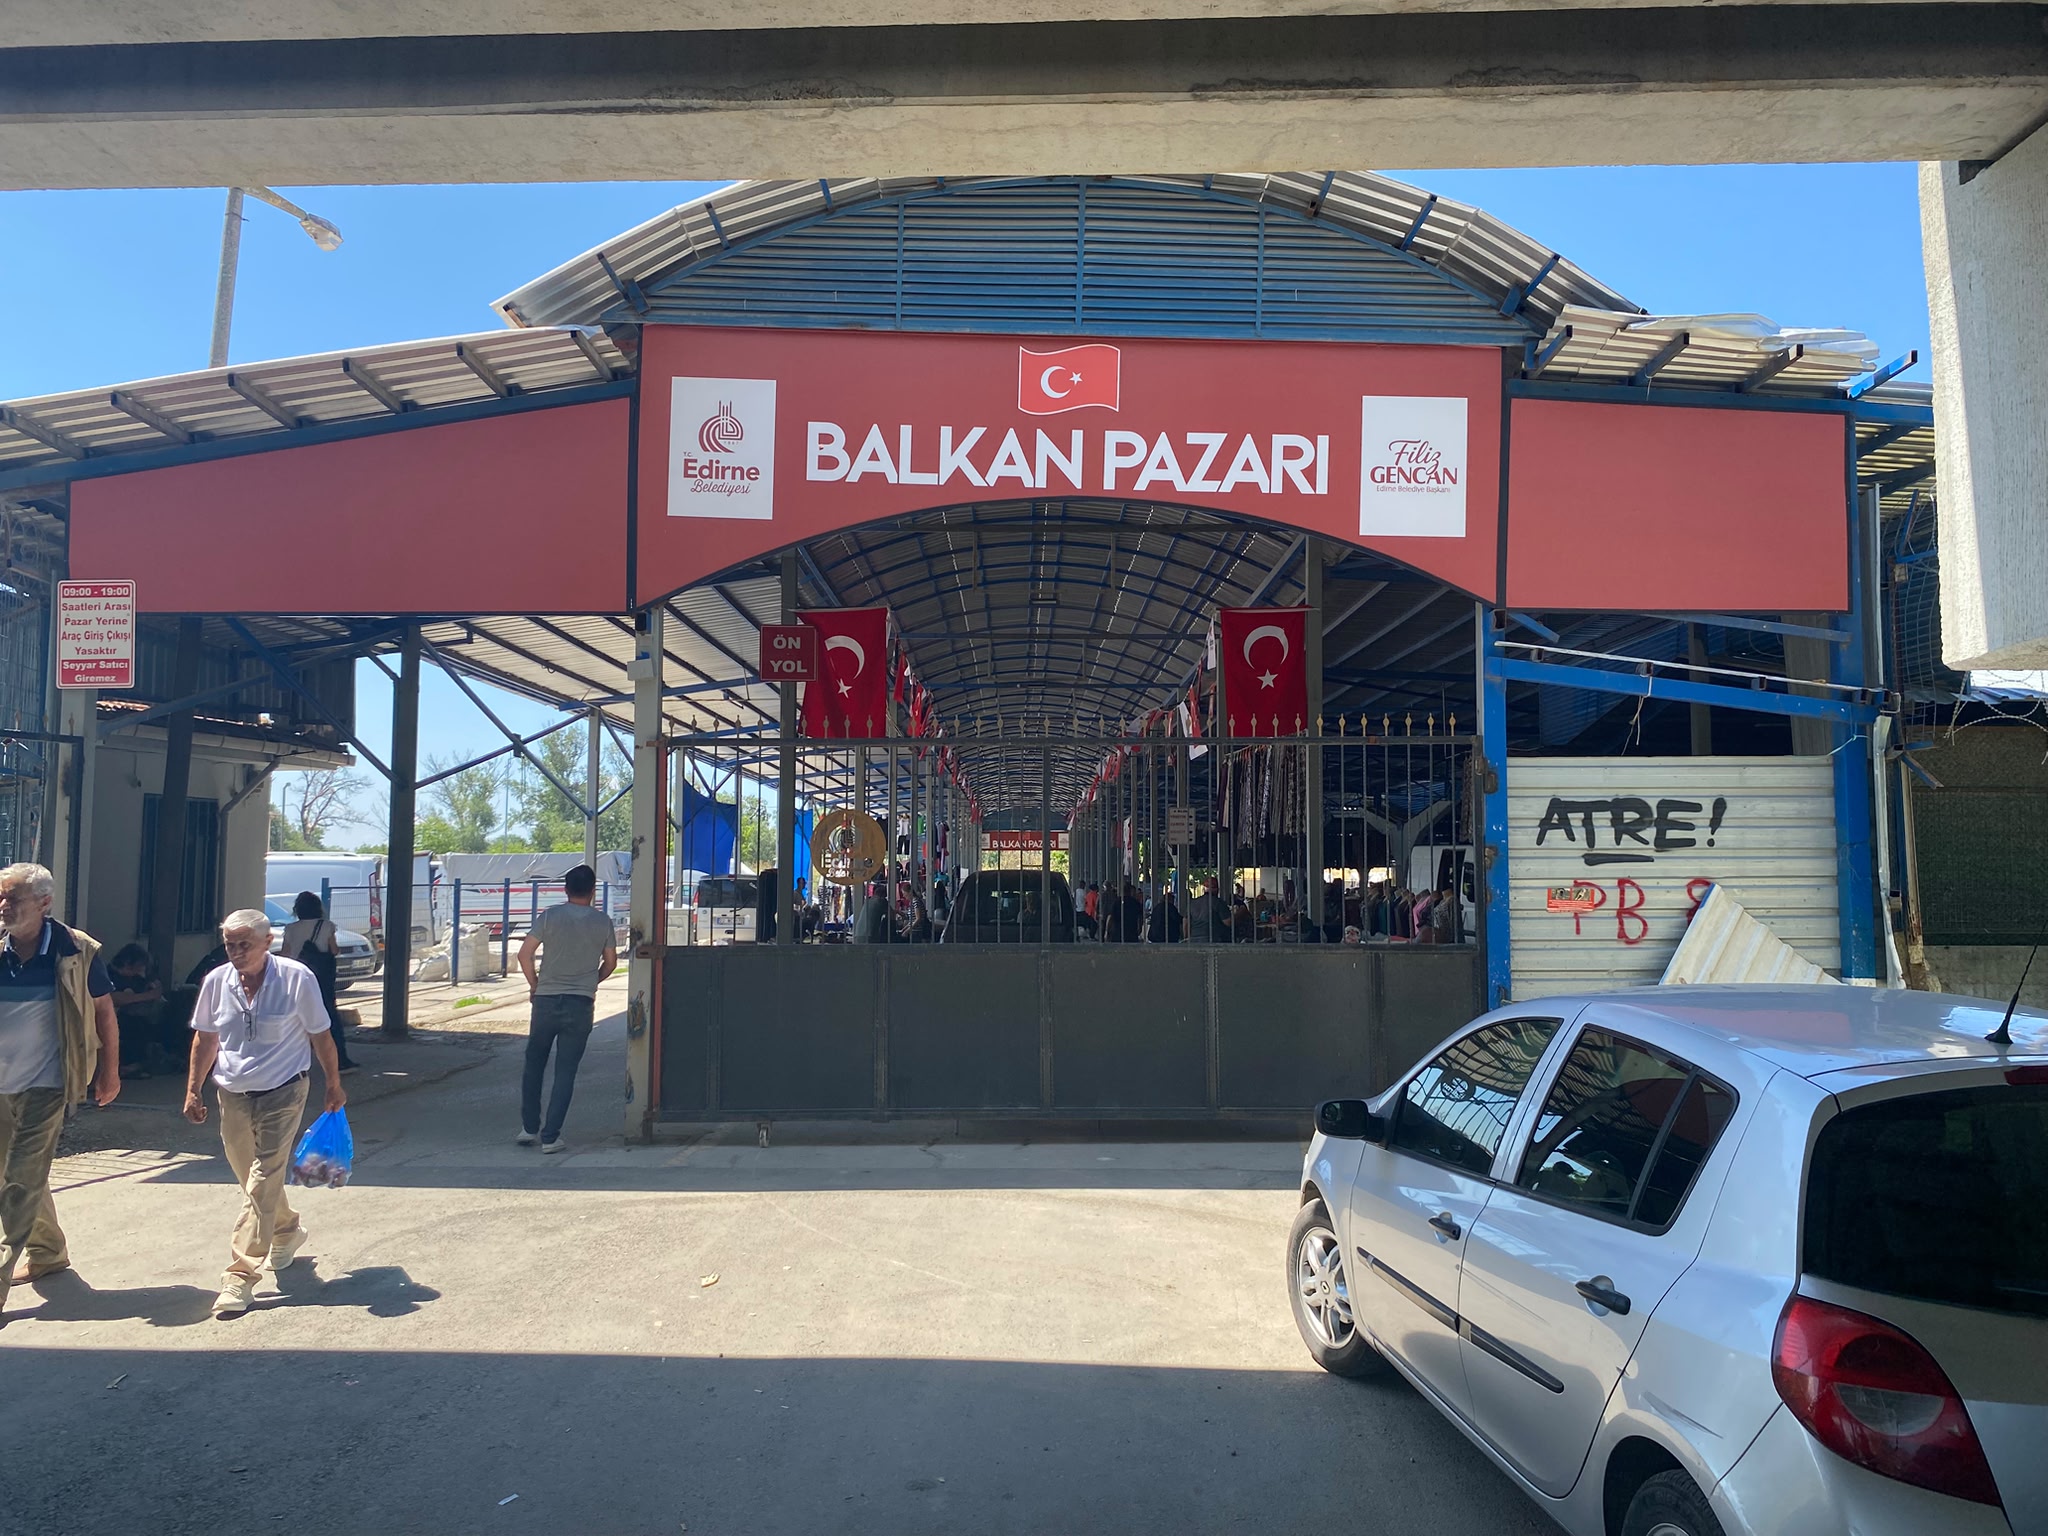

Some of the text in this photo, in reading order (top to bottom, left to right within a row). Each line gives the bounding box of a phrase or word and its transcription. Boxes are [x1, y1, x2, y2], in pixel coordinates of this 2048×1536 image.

[806, 421, 1329, 495] BALKAN PAZARI
[1388, 439, 1441, 476] Filiz
[683, 458, 760, 481] Edirne
[1370, 466, 1458, 485] GENCAN
[690, 479, 751, 497] Belediyesi
[1376, 485, 1396, 493] Edirne
[1398, 485, 1425, 494] Belediye
[63, 587, 92, 597] 09:00
[101, 587, 129, 596] 19:00
[62, 602, 131, 611] Saatleri Arası
[64, 617, 128, 626] Pazar Yerine
[61, 630, 131, 642] Araç Giriş Çıkışı
[773, 634, 801, 649] ÖN
[75, 646, 117, 655] Yasaktır
[63, 660, 128, 671] Seyyar Satıcı
[770, 660, 808, 673] YOL
[75, 674, 116, 683] Giremez
[1536, 797, 1727, 852] ATRE!
[1028, 840, 1057, 849] PAZRI
